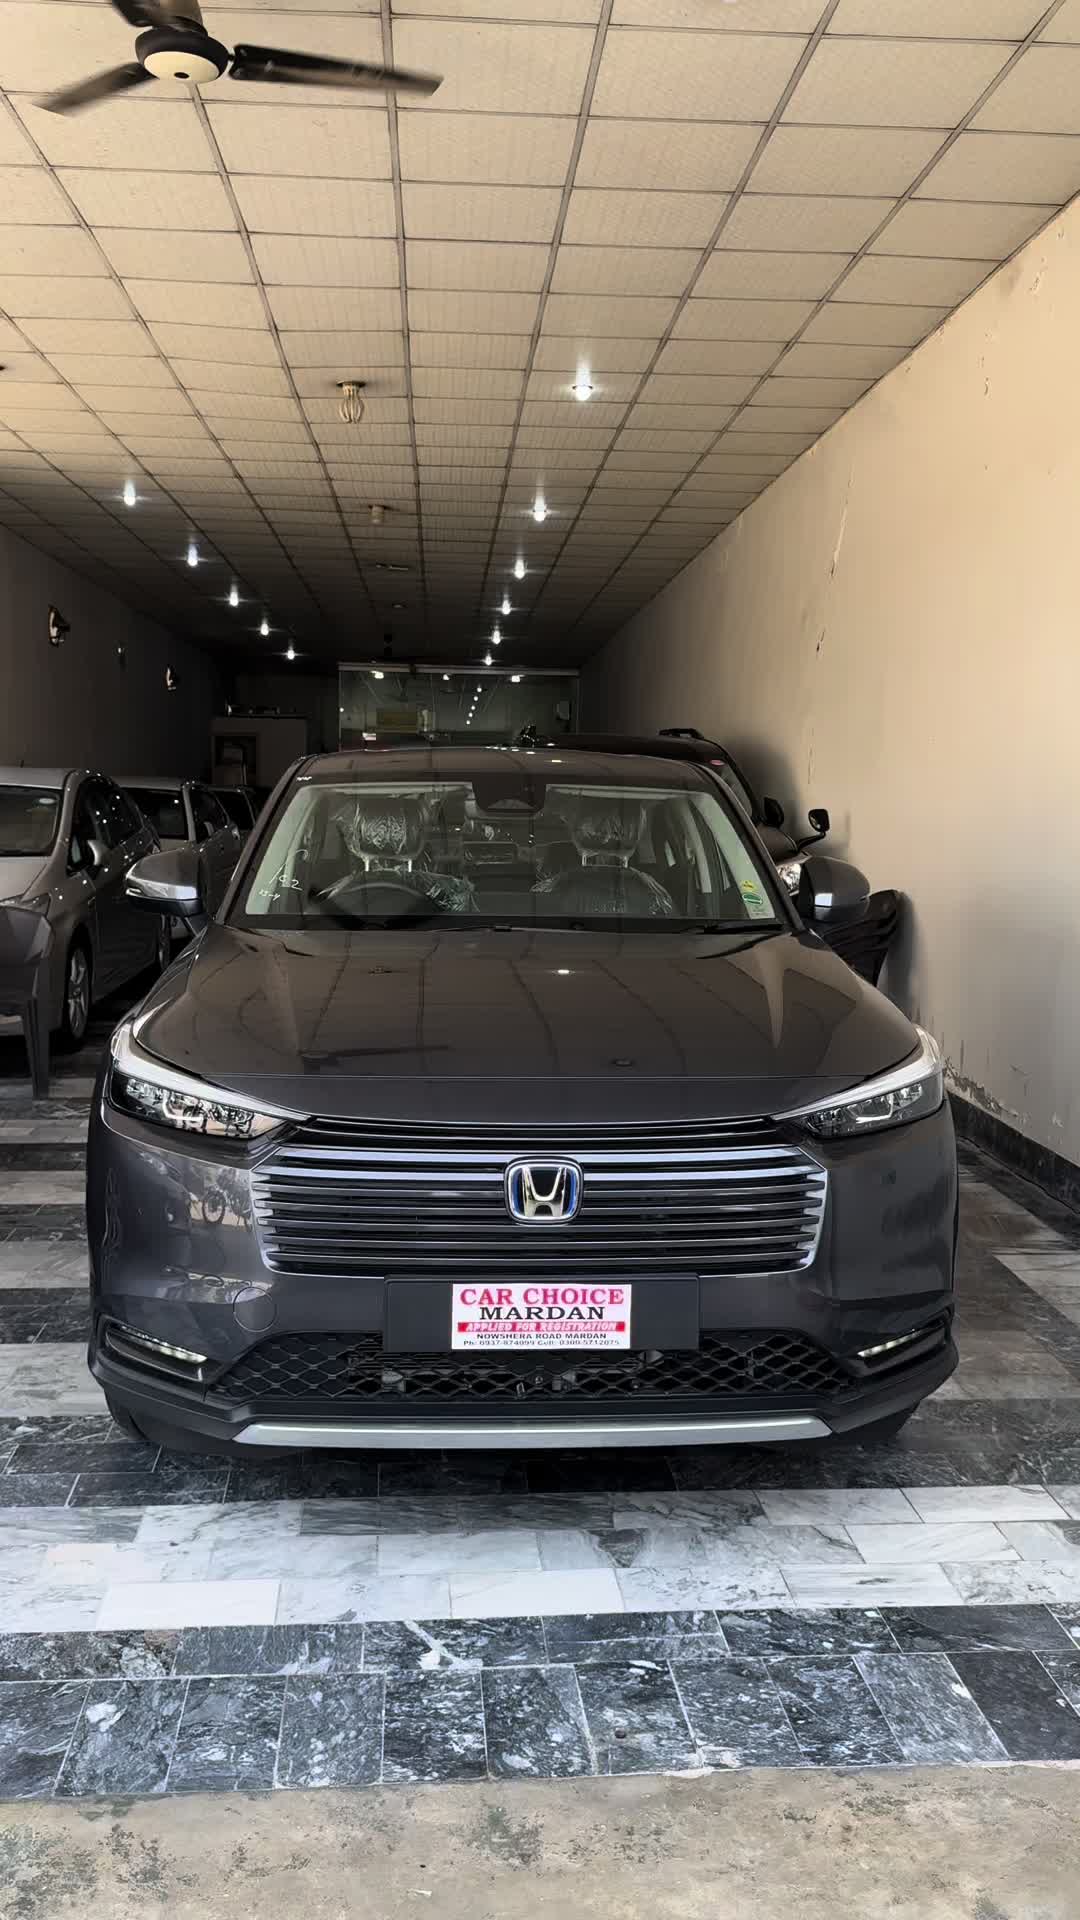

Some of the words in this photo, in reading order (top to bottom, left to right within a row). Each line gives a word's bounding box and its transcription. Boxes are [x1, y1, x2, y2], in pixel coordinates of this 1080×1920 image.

[460, 1288, 514, 1306] CAR
[523, 1288, 624, 1305] CHOICE
[479, 1306, 605, 1320] MARDAN
[466, 1322, 513, 1332] APPLIED
[515, 1322, 536, 1332] FOR
[539, 1322, 617, 1331] REGISTRATION
